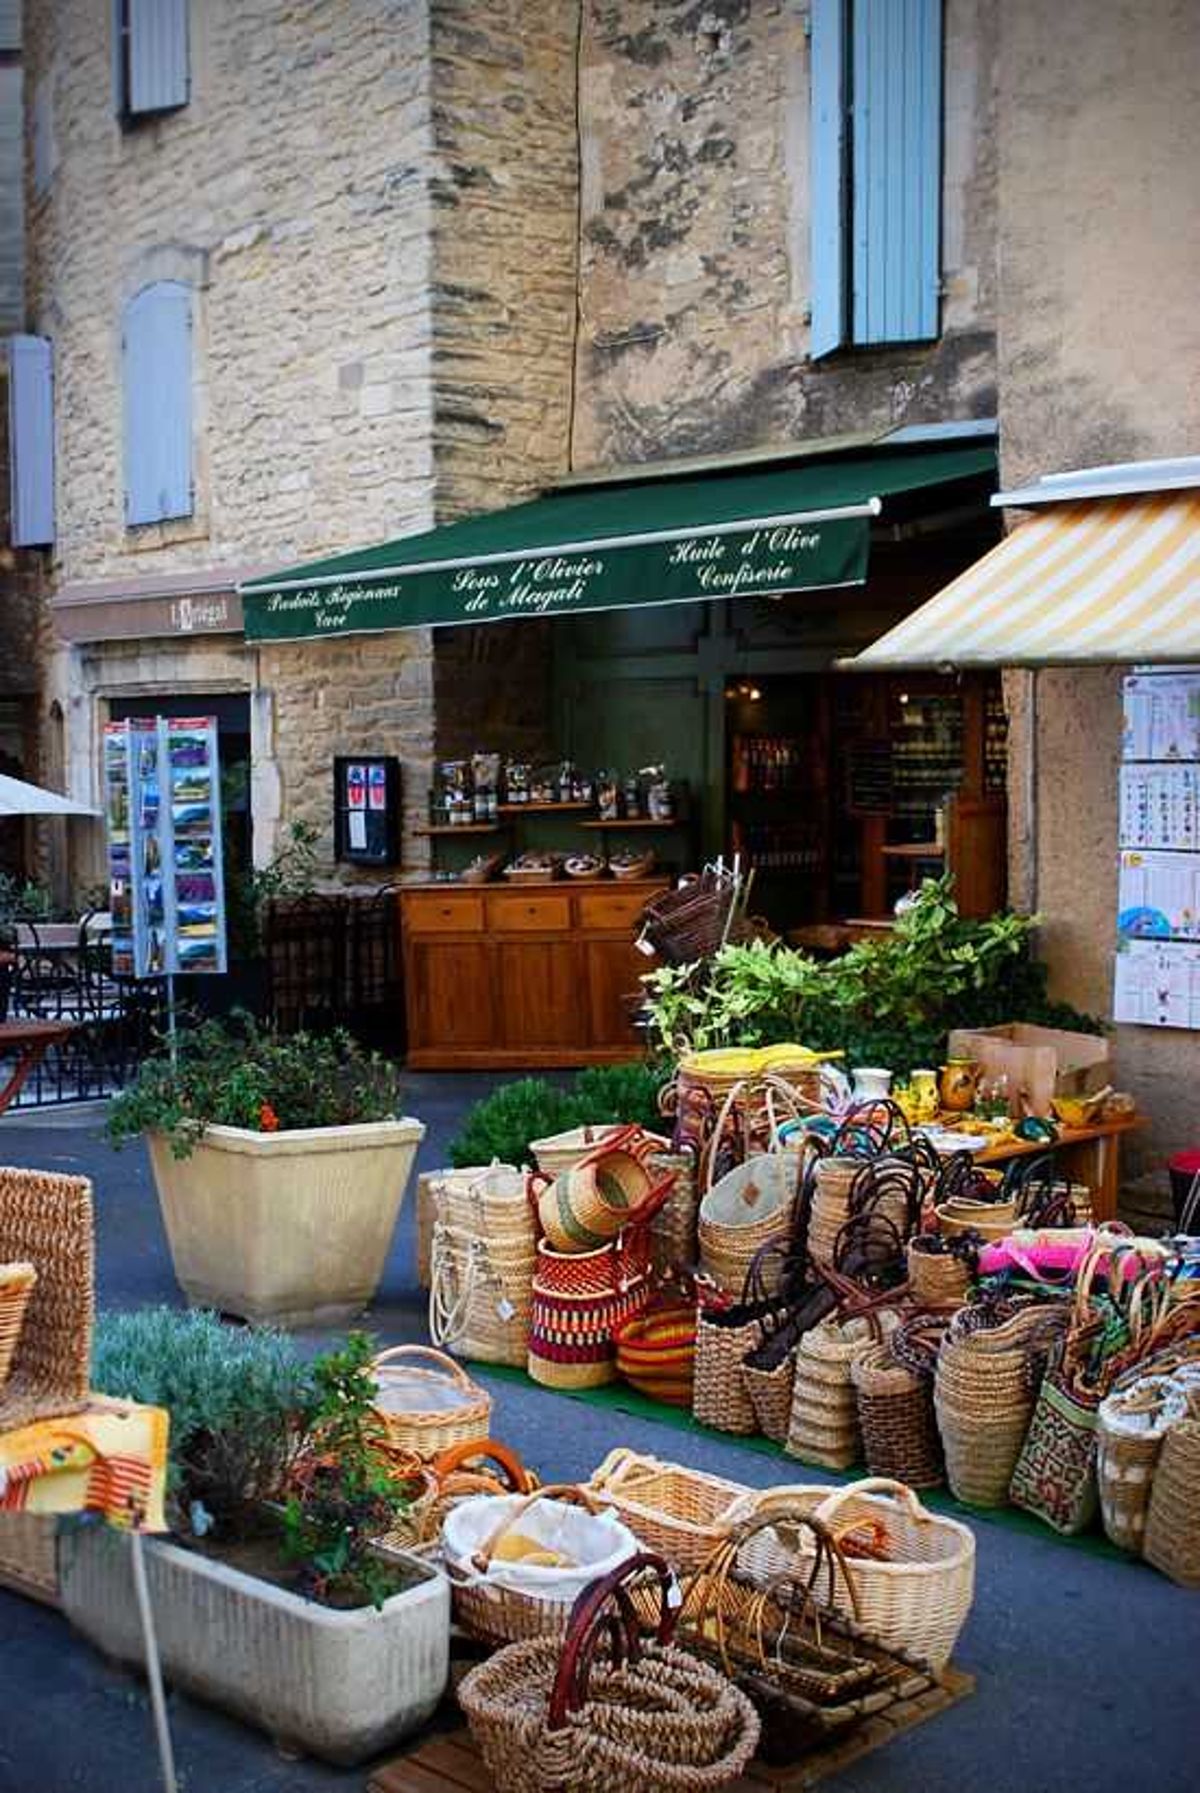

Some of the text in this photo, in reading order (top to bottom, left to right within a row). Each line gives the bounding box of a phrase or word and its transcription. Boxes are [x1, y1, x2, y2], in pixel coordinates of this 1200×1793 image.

[669, 526, 821, 563] Huile d'Olive
[697, 560, 793, 594] Confiserie
[464, 578, 587, 612] de Magali
[315, 608, 347, 628] Cave
